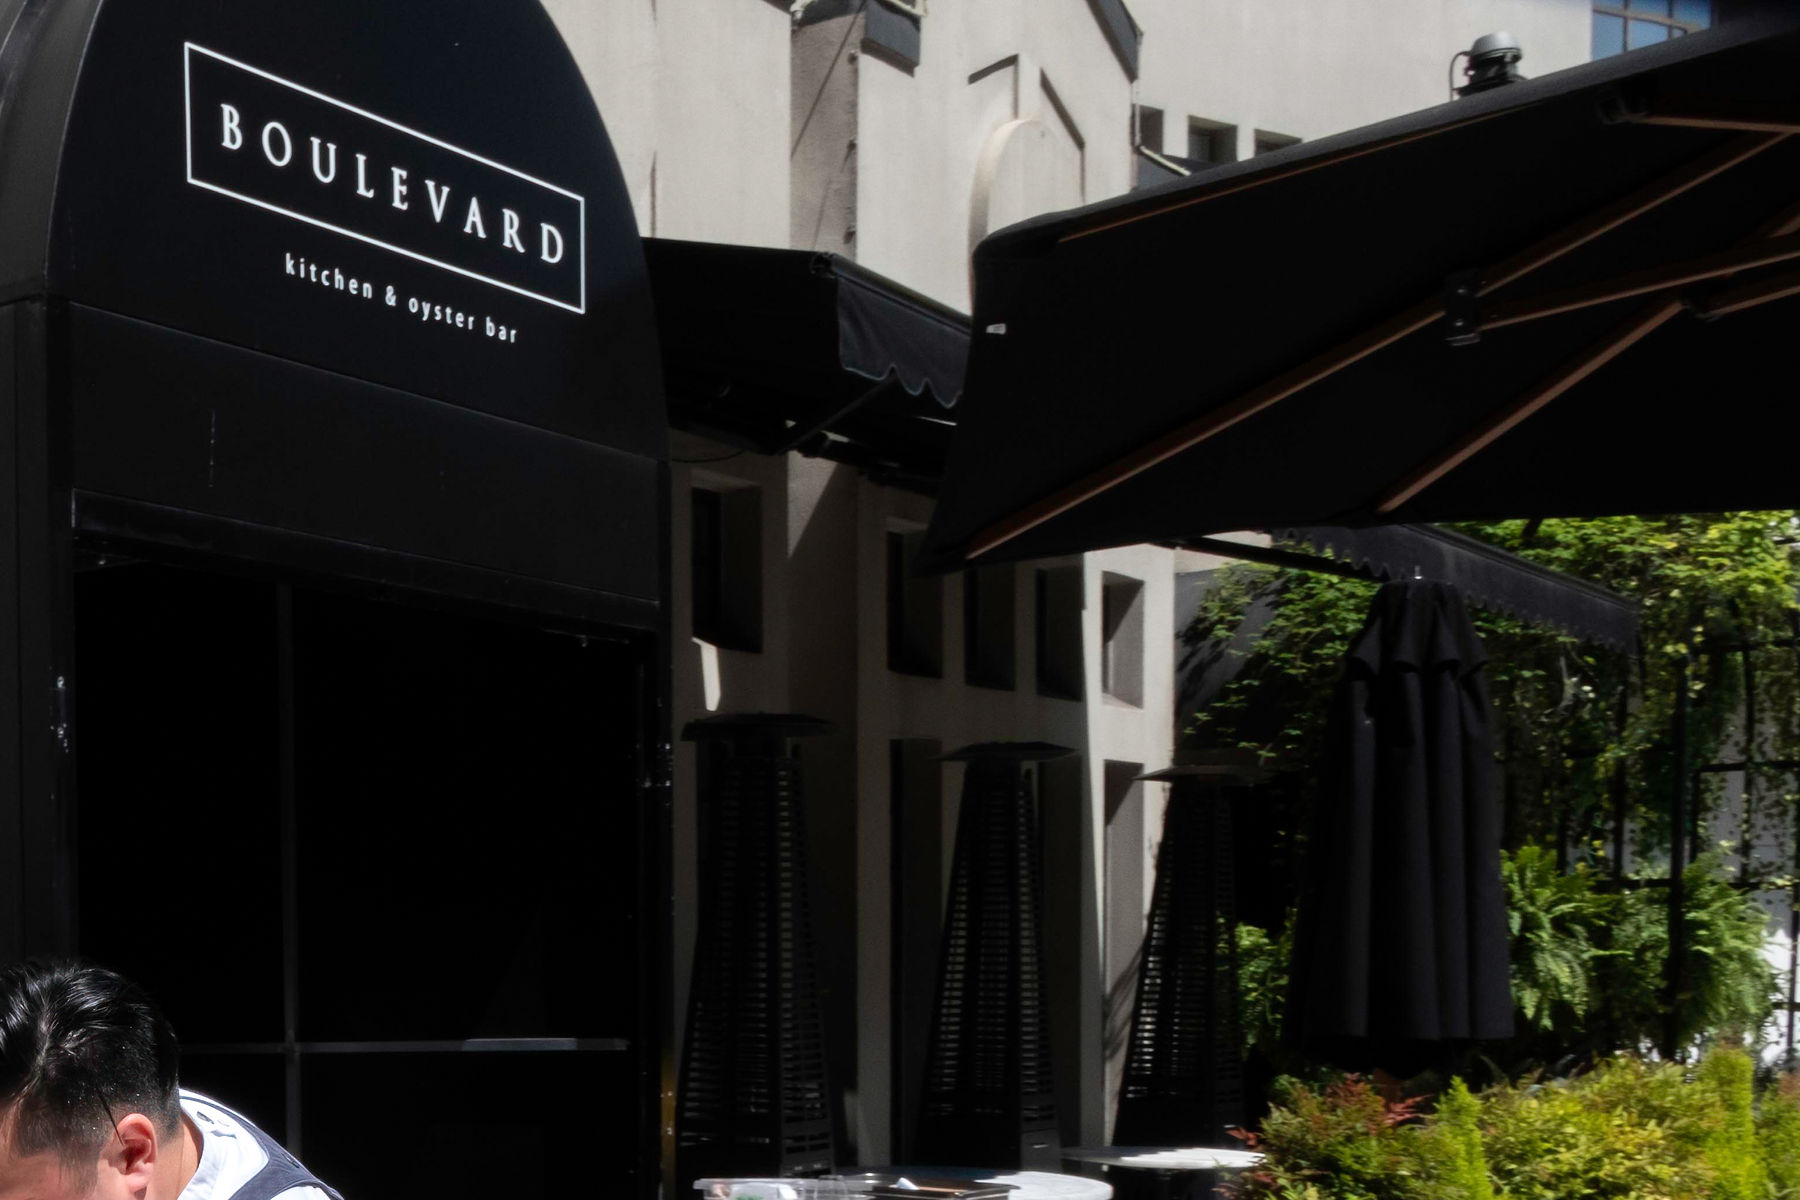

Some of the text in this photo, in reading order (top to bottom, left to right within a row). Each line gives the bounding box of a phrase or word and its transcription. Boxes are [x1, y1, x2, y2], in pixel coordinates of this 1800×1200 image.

[220, 103, 564, 264] BOULEVARD
[285, 253, 518, 344] kitchen & oyster bar
